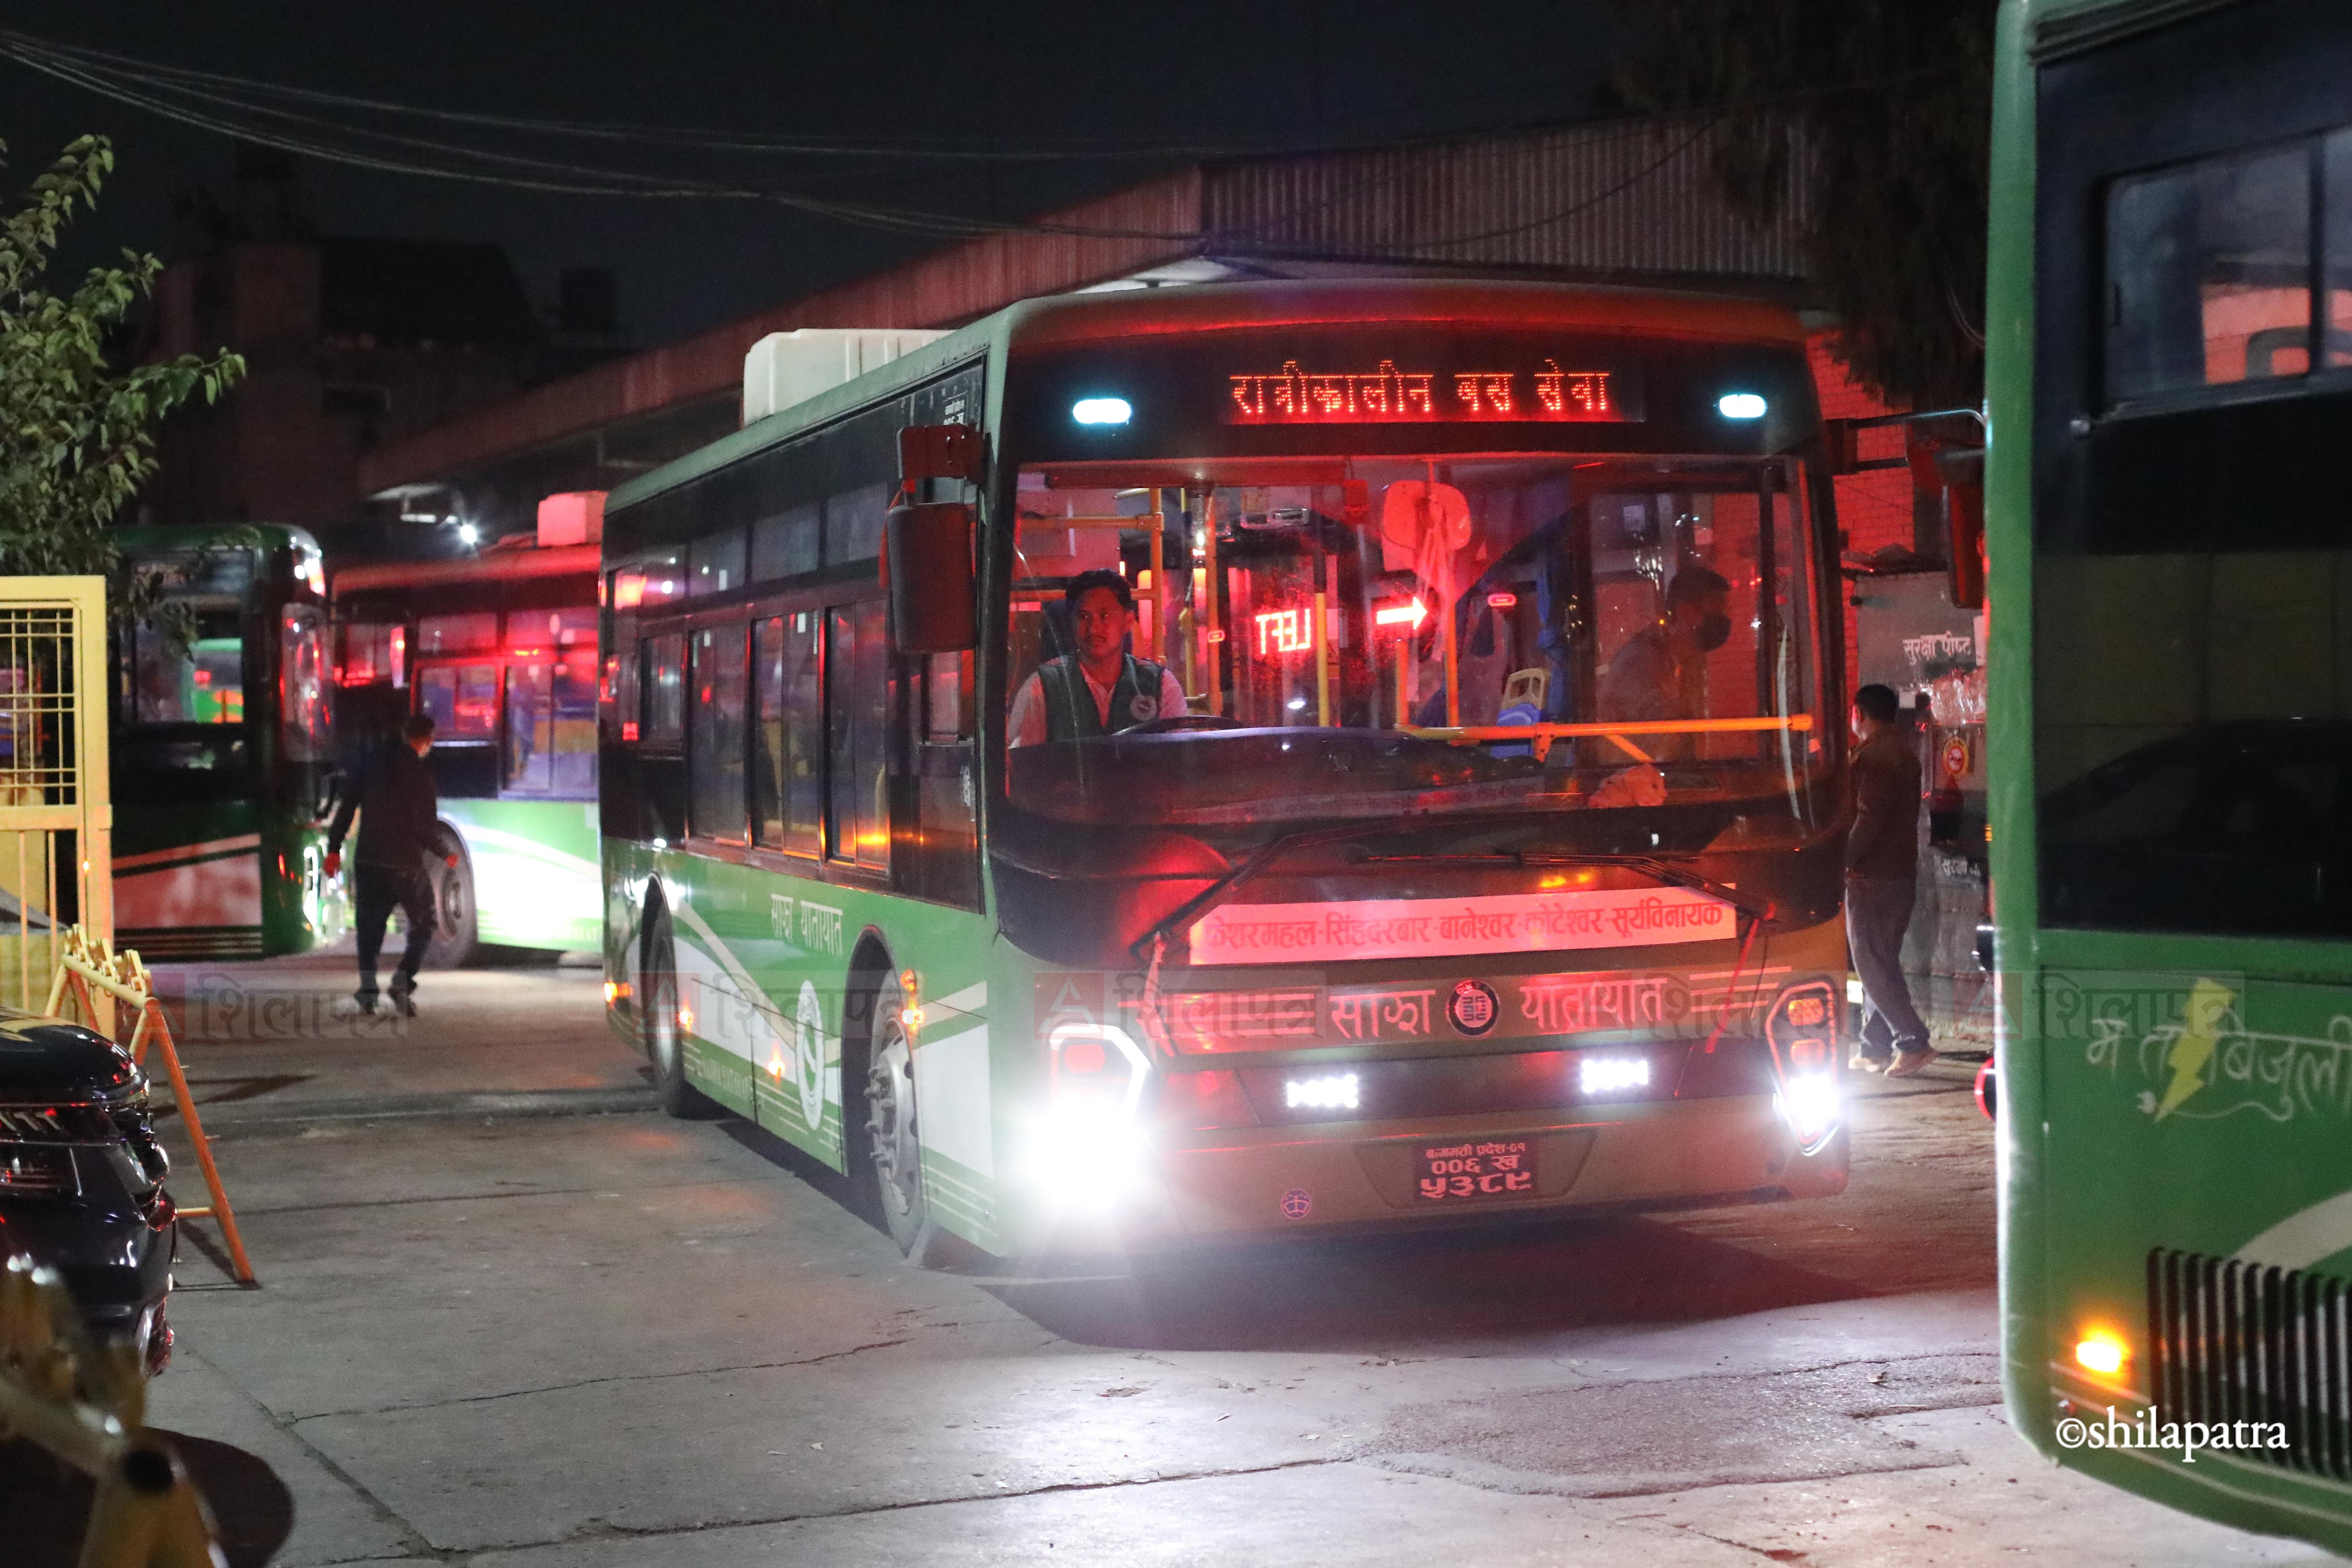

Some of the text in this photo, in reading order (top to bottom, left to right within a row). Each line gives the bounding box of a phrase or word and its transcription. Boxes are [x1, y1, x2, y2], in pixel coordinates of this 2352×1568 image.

[1454, 374, 1514, 411] बस
[1534, 359, 1610, 411] सेवा
[800, 900, 843, 957] यातायात
[1328, 978, 1668, 1039] साझा यातायात
[1491, 1154, 1521, 1171] ख
